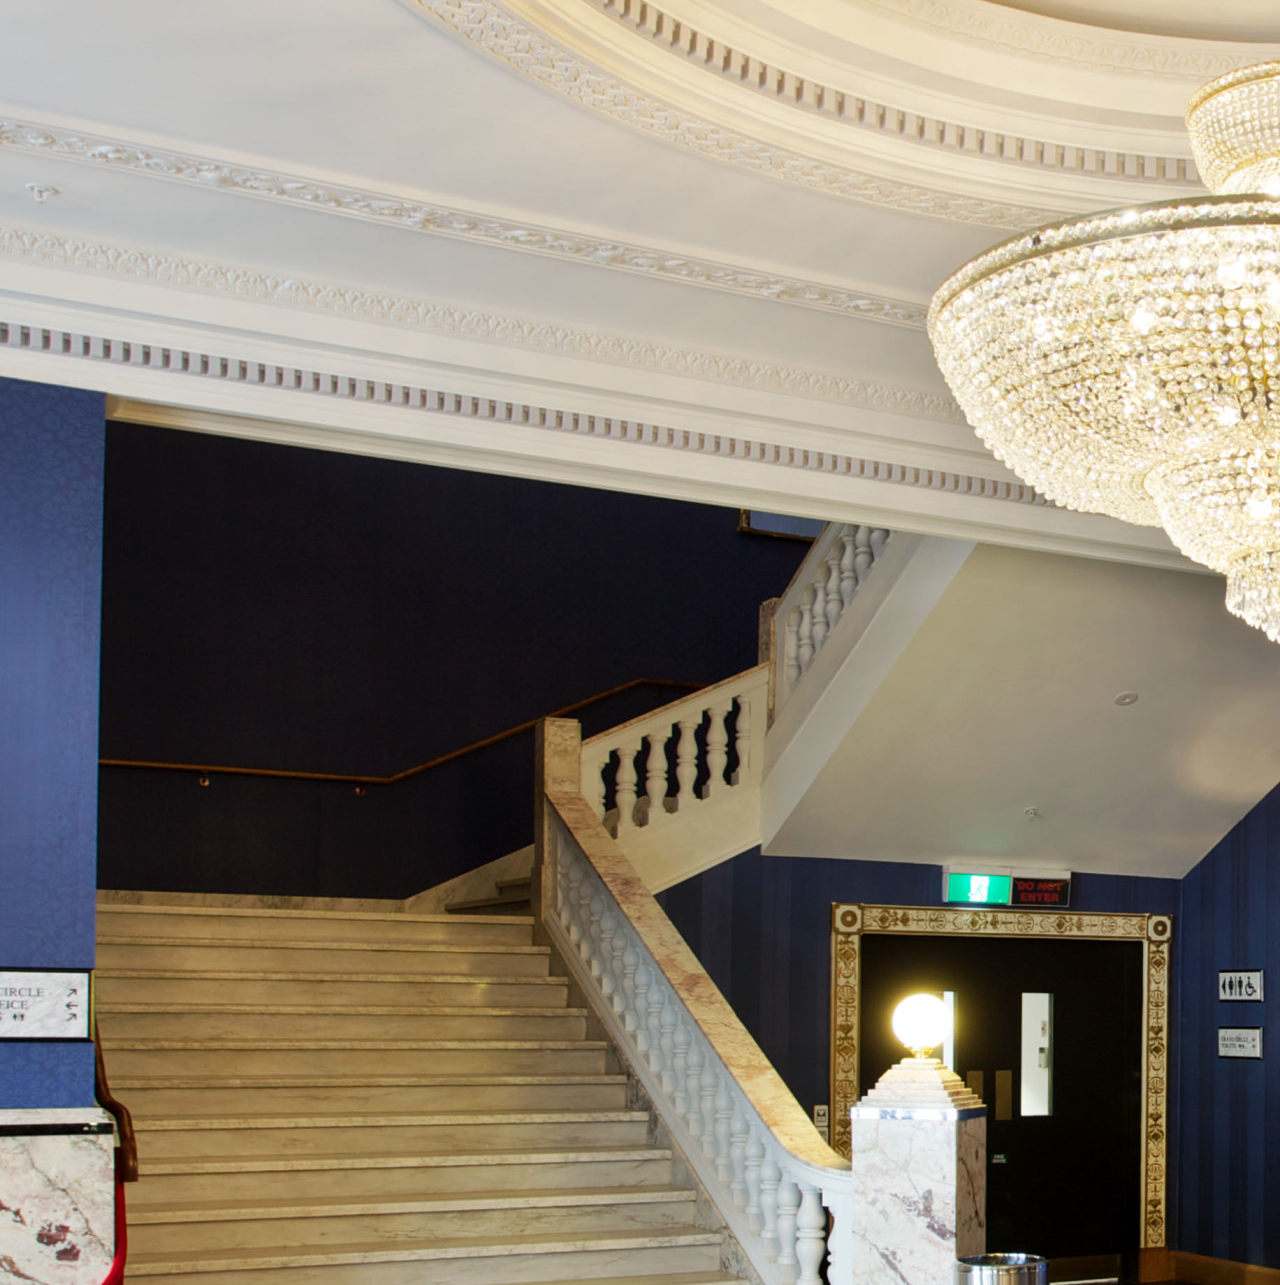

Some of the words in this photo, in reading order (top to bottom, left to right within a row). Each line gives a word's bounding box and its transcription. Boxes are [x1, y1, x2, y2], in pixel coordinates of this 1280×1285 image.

[1017, 881, 1035, 891] DO
[1037, 882, 1064, 892] NOT
[1020, 892, 1060, 903] ENTER
